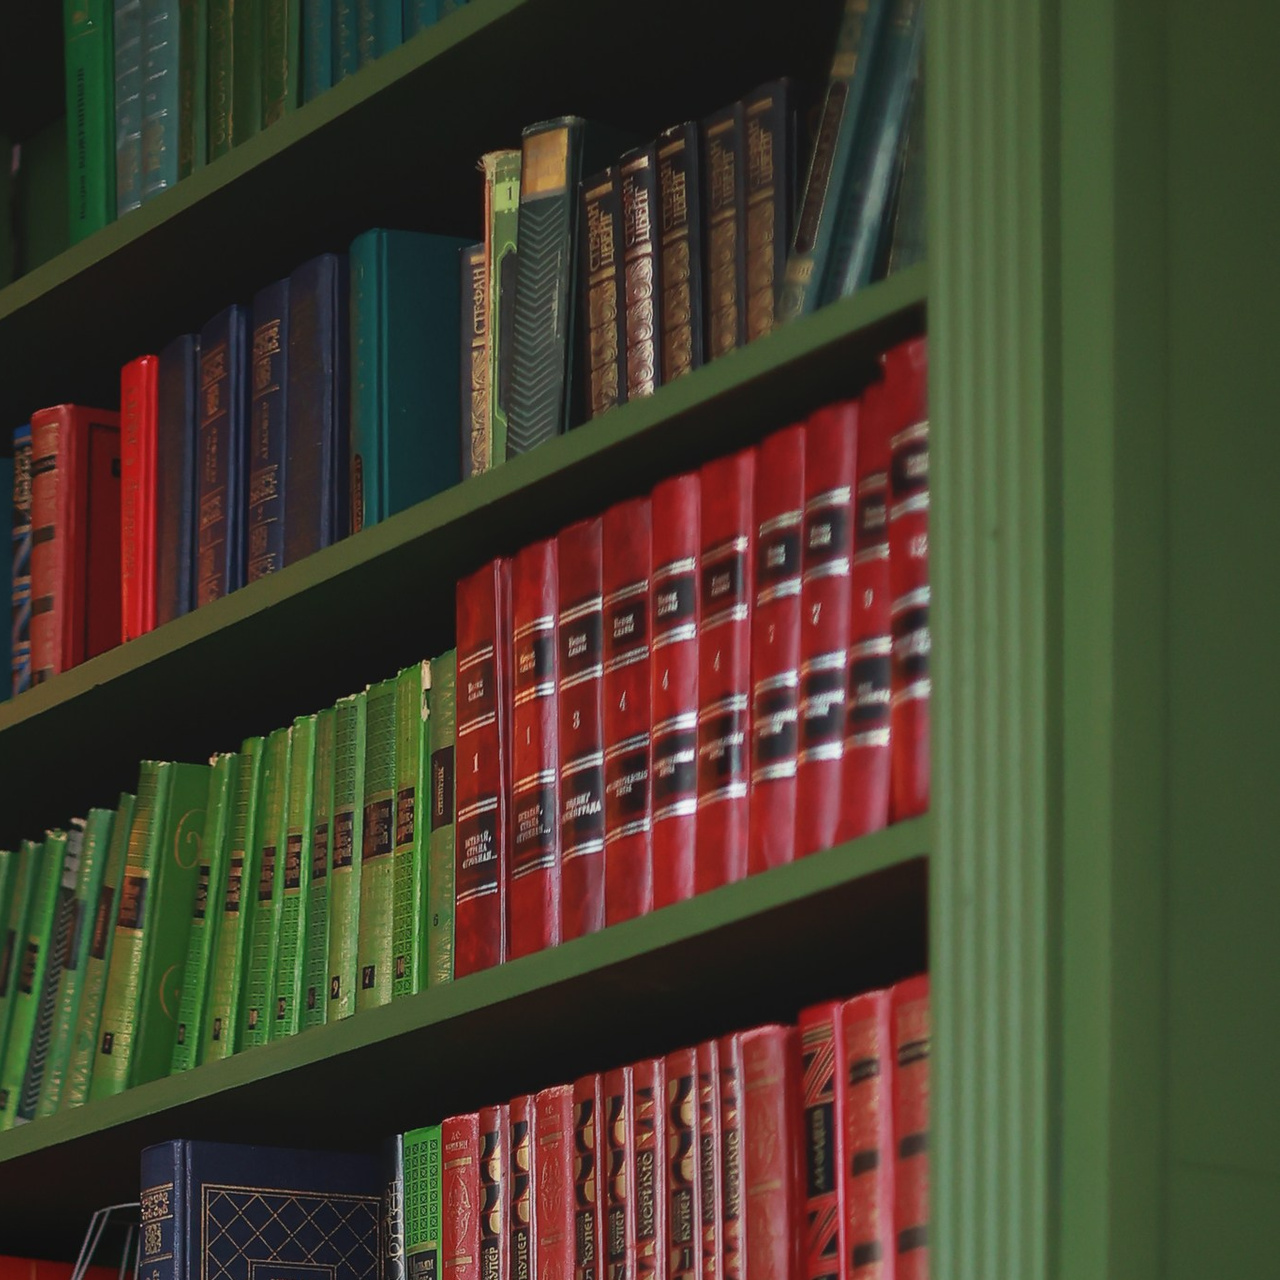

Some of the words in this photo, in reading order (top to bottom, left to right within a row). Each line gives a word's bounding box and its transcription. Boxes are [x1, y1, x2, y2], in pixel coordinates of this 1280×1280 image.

[572, 711, 581, 730] 3
[472, 752, 479, 773] 1
[583, 1212, 593, 1261] КУПЕР
[518, 1232, 528, 1280] КУПЕР
